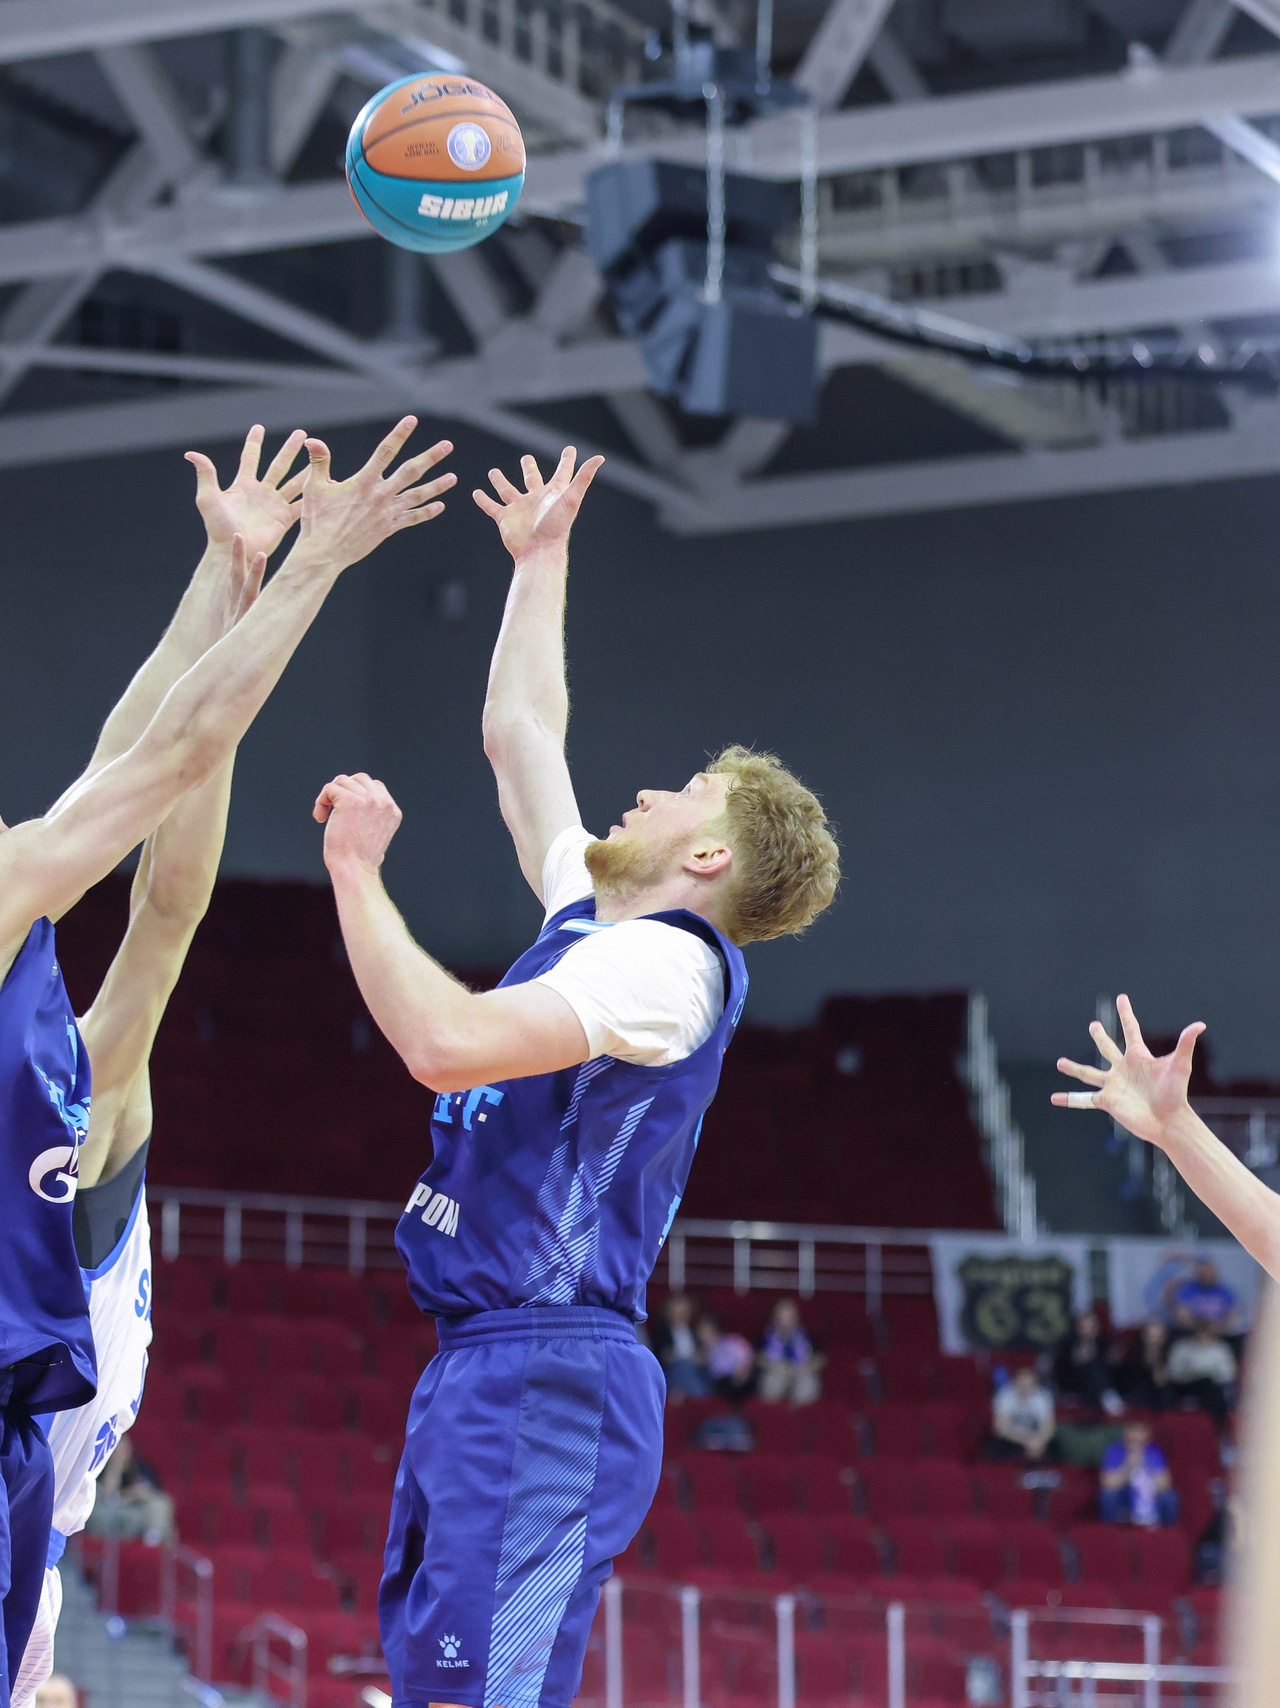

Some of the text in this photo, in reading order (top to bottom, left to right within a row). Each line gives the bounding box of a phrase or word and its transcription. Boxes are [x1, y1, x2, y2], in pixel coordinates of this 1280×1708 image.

[418, 190, 509, 221] SIBUR
[975, 1288, 1069, 1345] 63
[436, 1659, 470, 1668] KELME
